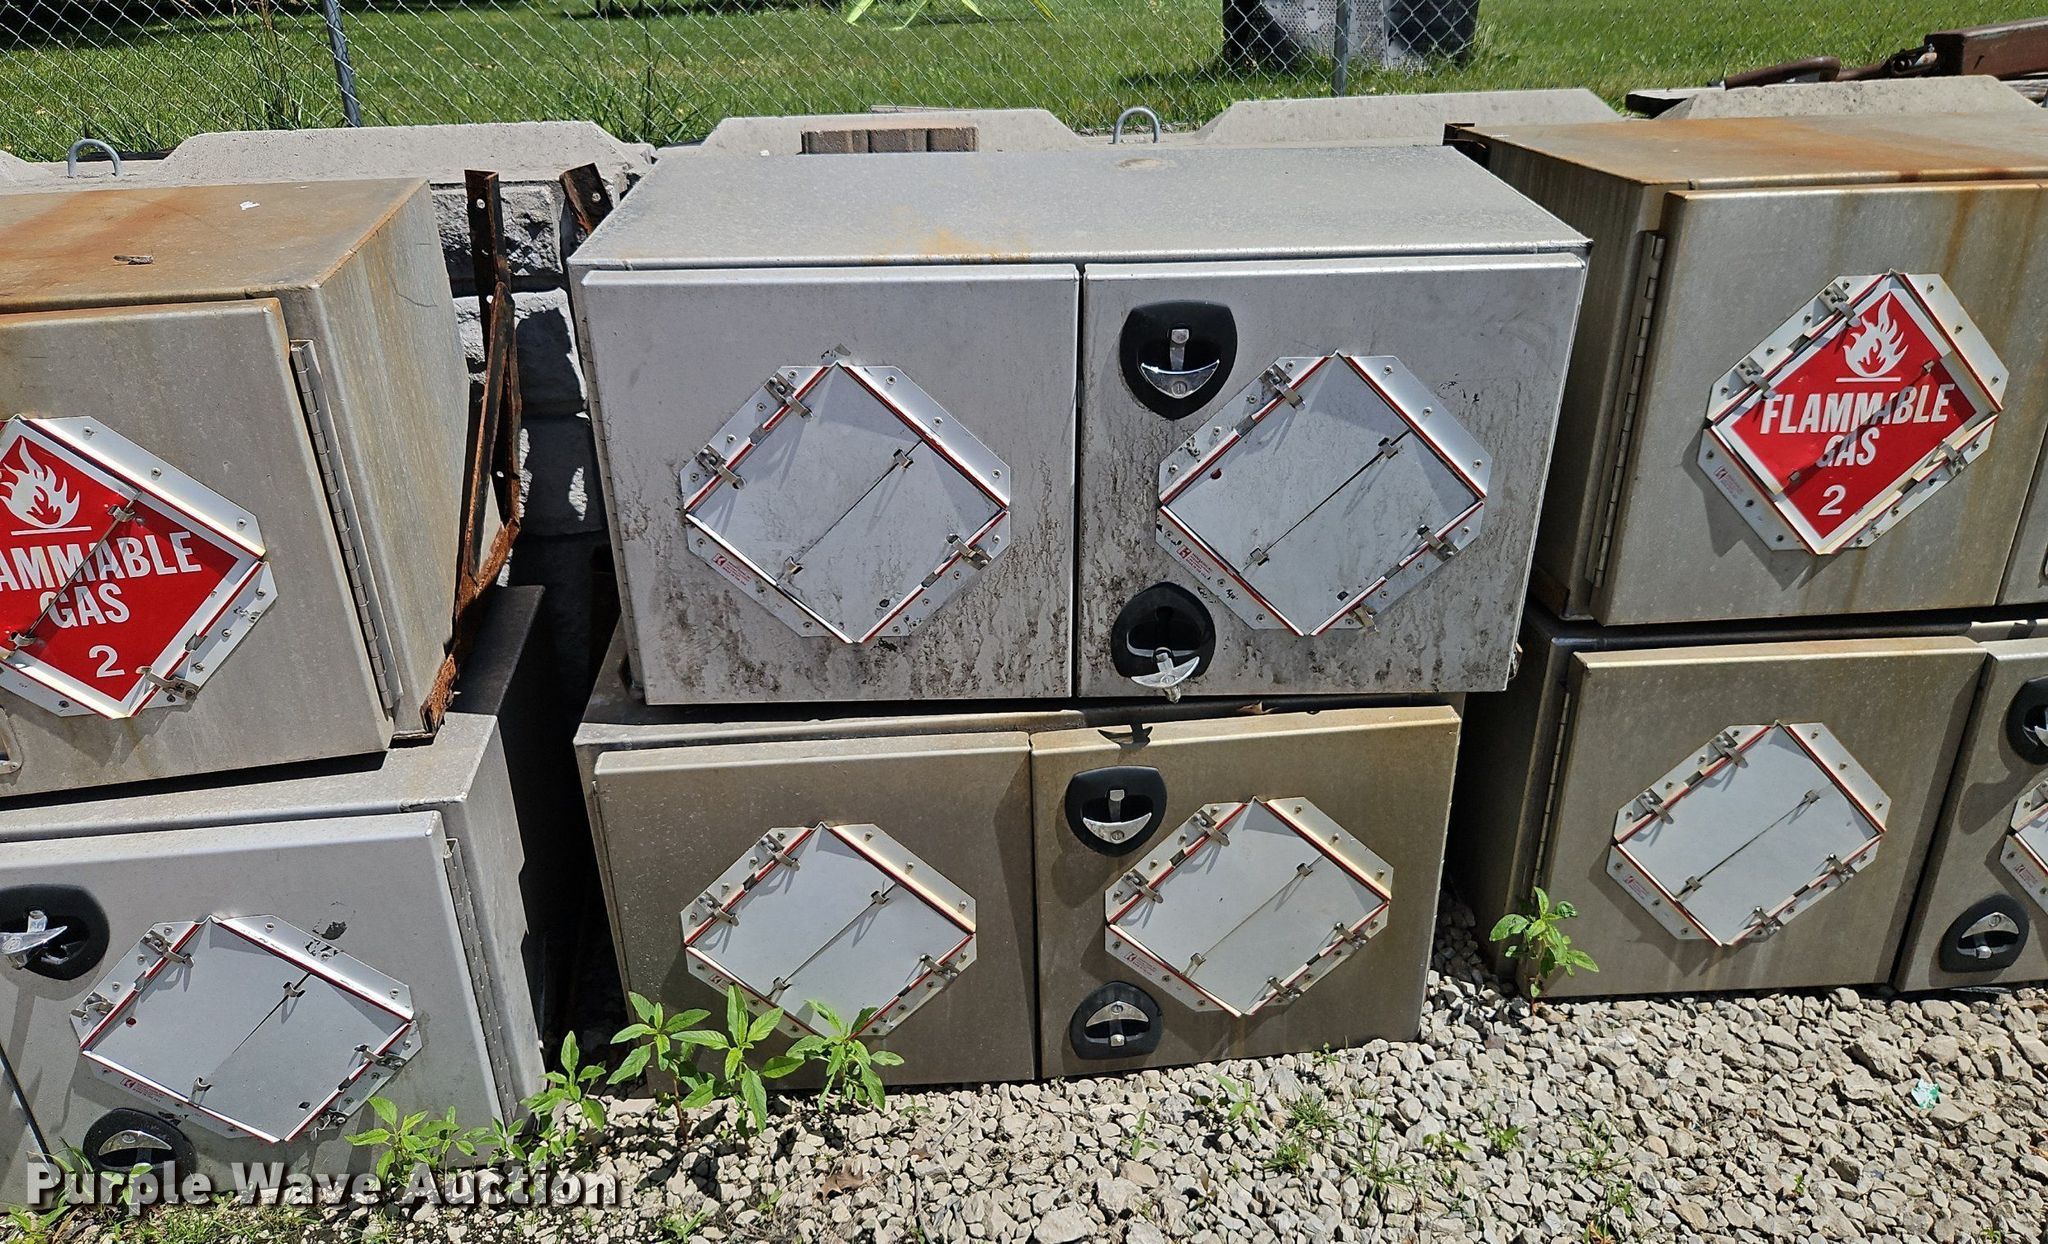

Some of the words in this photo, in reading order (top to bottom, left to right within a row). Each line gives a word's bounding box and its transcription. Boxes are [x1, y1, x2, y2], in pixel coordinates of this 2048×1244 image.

[1760, 384, 1955, 434] FLAMMABLE
[1823, 427, 1880, 467] GAS
[1818, 485, 1846, 516] 2
[39, 582, 130, 629] GAS
[88, 645, 125, 678] 2
